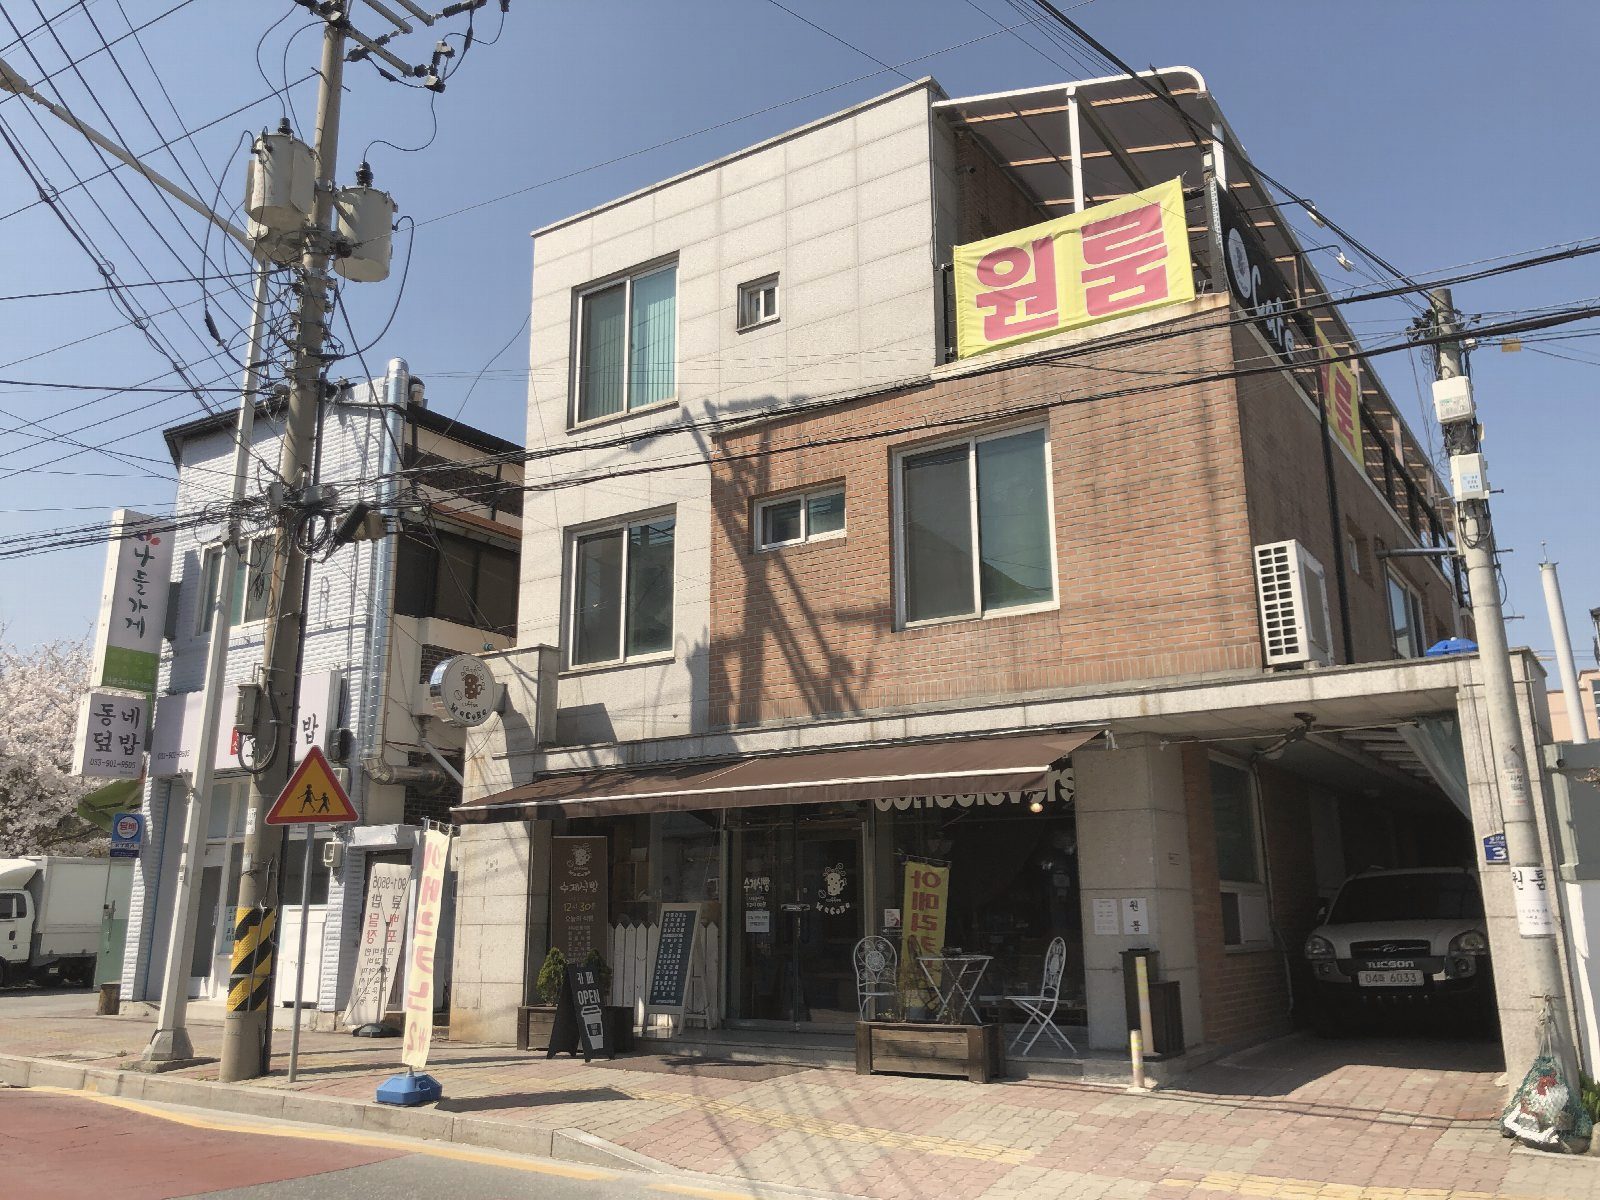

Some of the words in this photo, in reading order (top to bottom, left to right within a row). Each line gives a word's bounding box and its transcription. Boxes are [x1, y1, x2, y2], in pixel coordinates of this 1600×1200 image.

[976, 202, 1168, 341] 원룸
[125, 545, 155, 639] 나들가게
[94, 704, 140, 729] 동네
[302, 713, 319, 745] 밥
[93, 730, 140, 756] 덮밥
[577, 989, 601, 1006] OPEN
